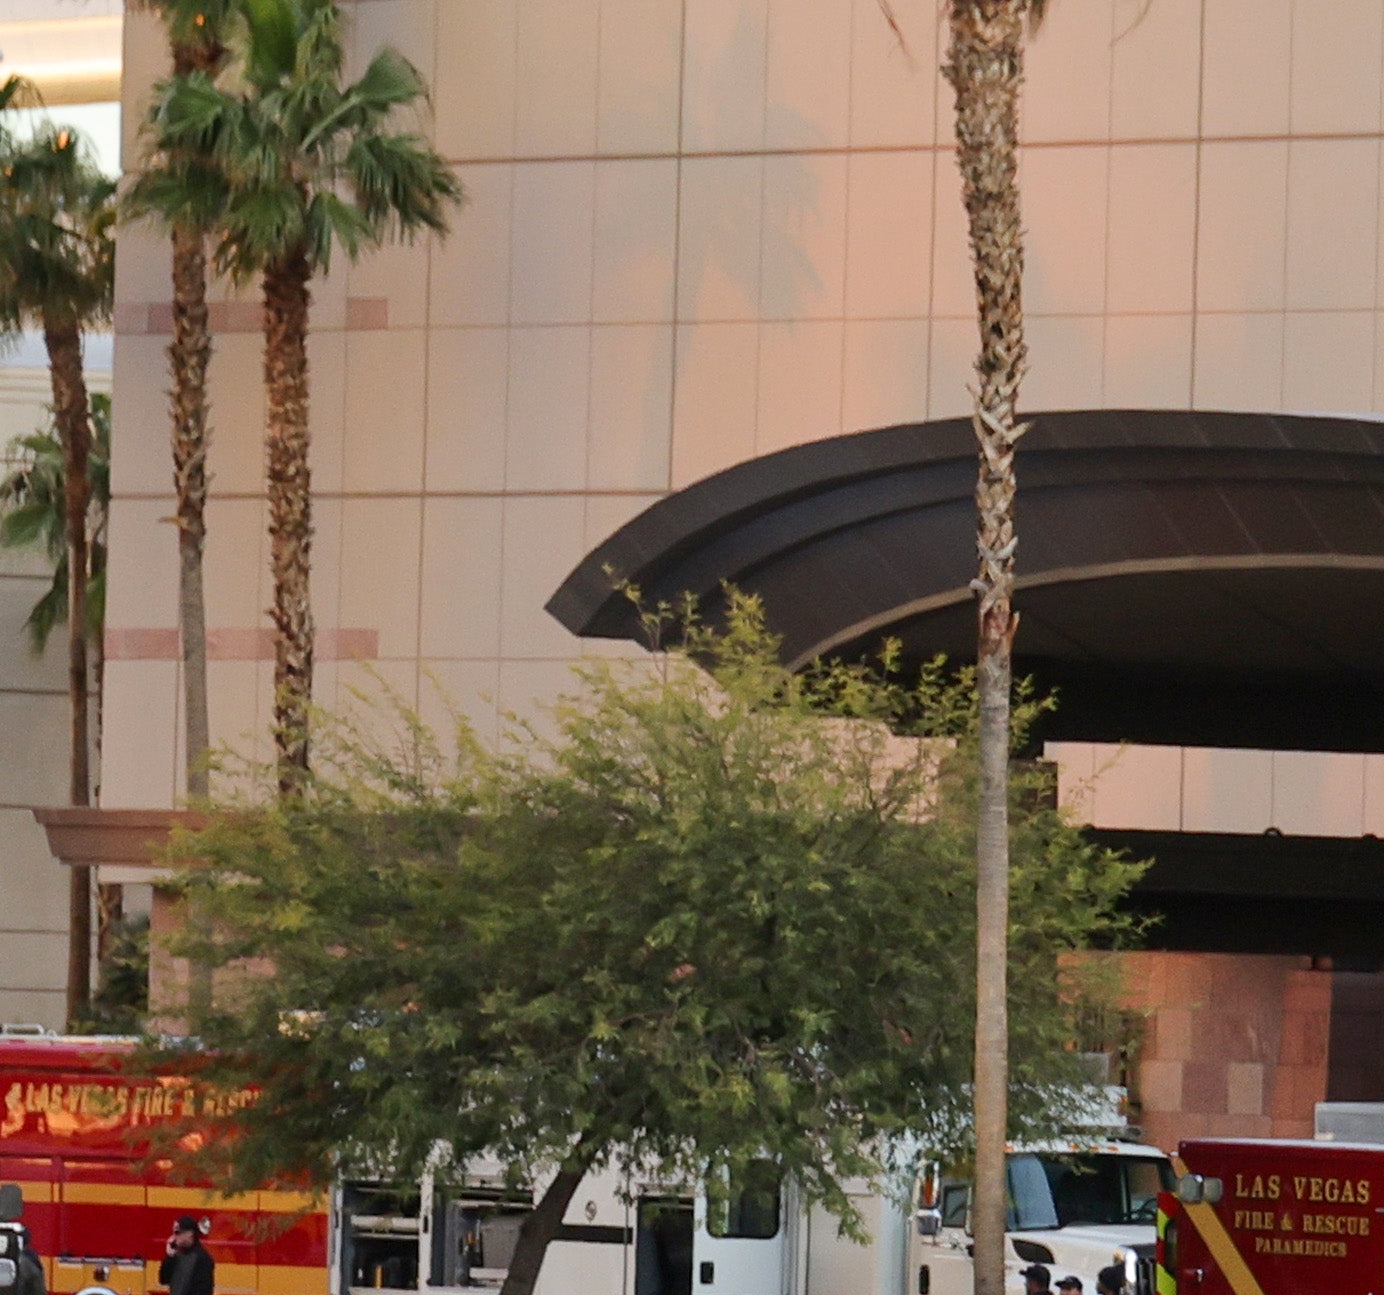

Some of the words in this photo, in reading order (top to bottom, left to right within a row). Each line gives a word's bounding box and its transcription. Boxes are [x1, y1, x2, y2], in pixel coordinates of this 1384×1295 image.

[26, 1082, 62, 1112] LAS
[1234, 1174, 1281, 1199] LAS
[1294, 1176, 1370, 1204] VEGAS
[1234, 1210, 1274, 1230] FIRE
[1280, 1212, 1293, 1231] &
[1303, 1214, 1370, 1236] RESCUE
[1255, 1237, 1347, 1257] PARAMEDICS
